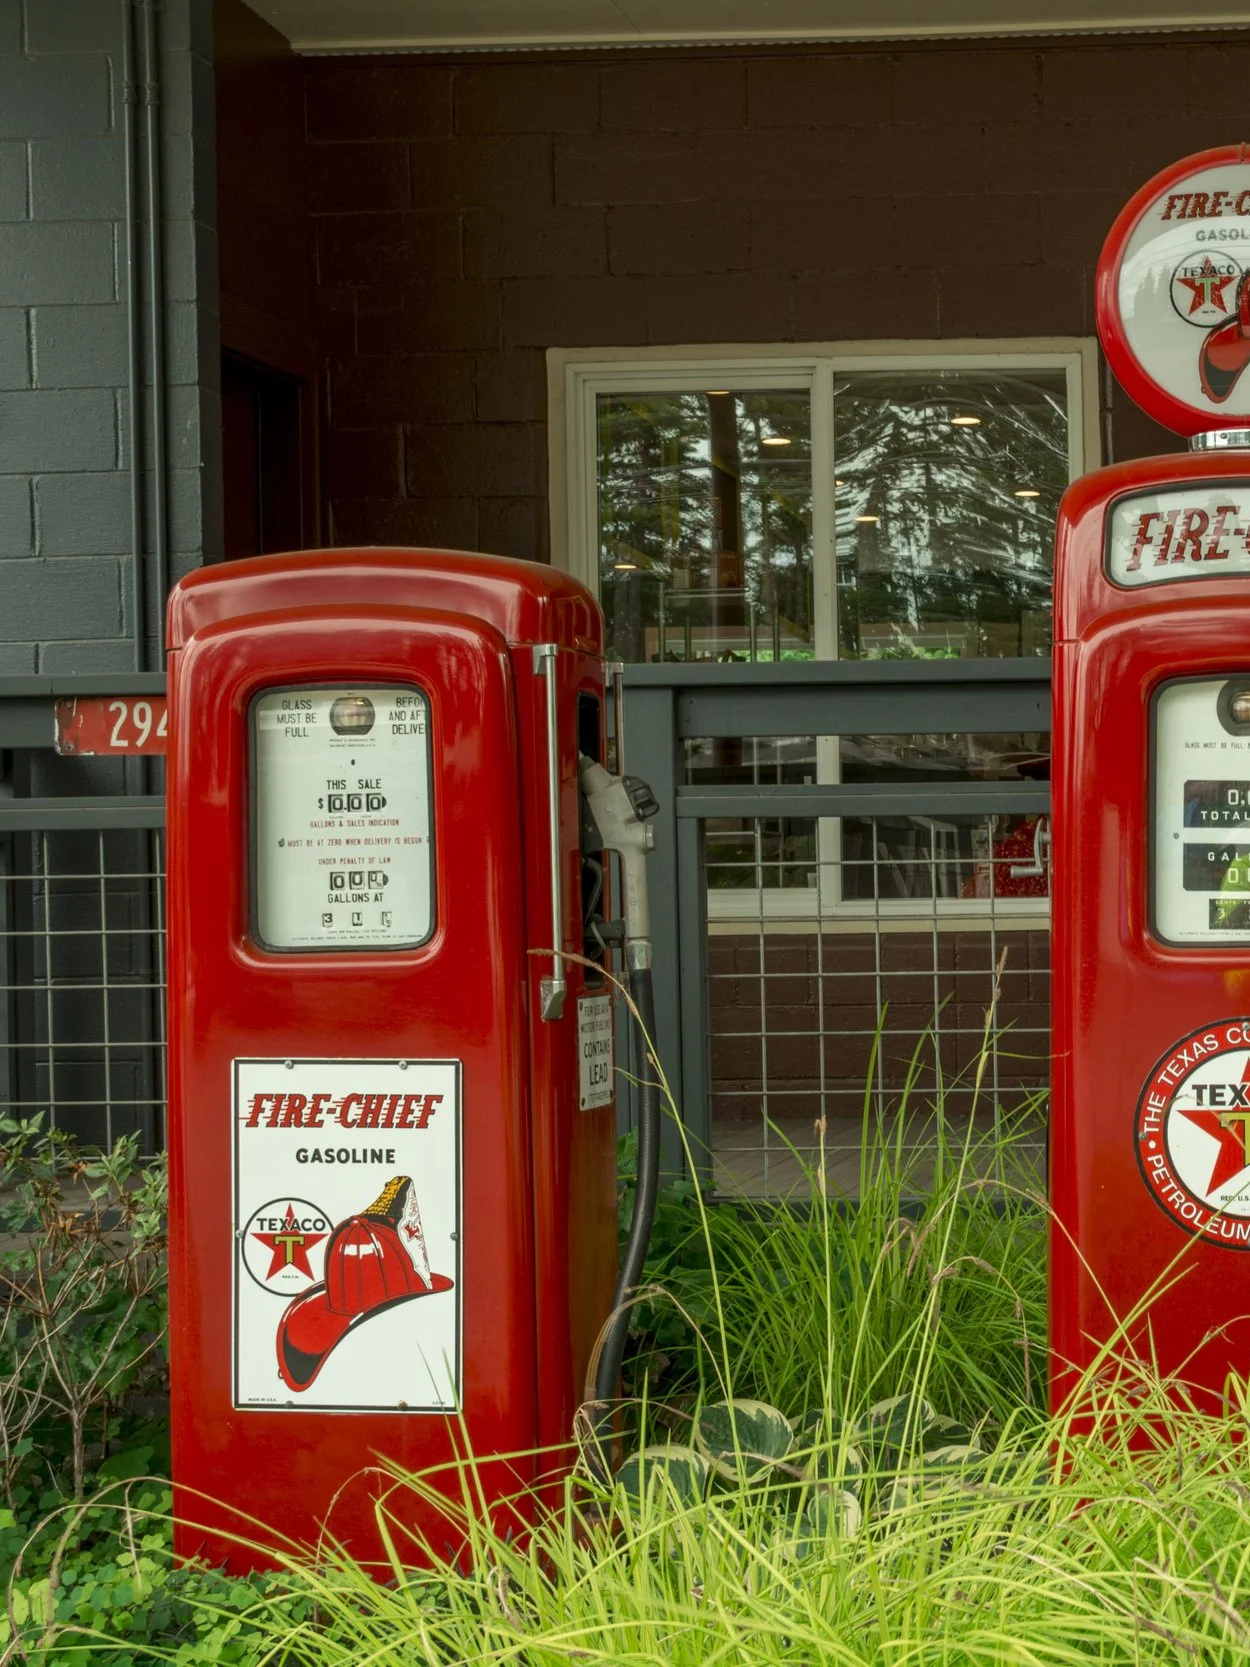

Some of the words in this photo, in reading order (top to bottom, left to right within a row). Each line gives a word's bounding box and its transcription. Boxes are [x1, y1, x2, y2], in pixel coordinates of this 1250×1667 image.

[1182, 263, 1236, 278] TEXACO
[282, 700, 312, 711] GLASS
[396, 696, 425, 708] BEFO
[277, 714, 302, 724] MUST
[305, 713, 317, 723] BE
[389, 711, 407, 721] AND
[285, 727, 309, 737] FULL
[326, 779, 347, 790] THIS
[358, 779, 382, 789] SALE
[1201, 811, 1250, 821] TOTAL
[310, 820, 336, 828] GALLONS
[346, 838, 361, 846] WHEN
[340, 857, 365, 865] PENALTY
[379, 856, 391, 864] LAW
[328, 893, 370, 903] GALLONS
[373, 892, 384, 902] AT
[584, 1039, 611, 1058] CONTAINS
[589, 1062, 608, 1086] LEAD
[1144, 1092, 1167, 1134] THE
[1157, 1034, 1219, 1086] TEXAS
[245, 1093, 444, 1129] FIRE-CHIEF
[296, 1148, 396, 1164] GASOLINE
[256, 1217, 326, 1232] TEXACO
